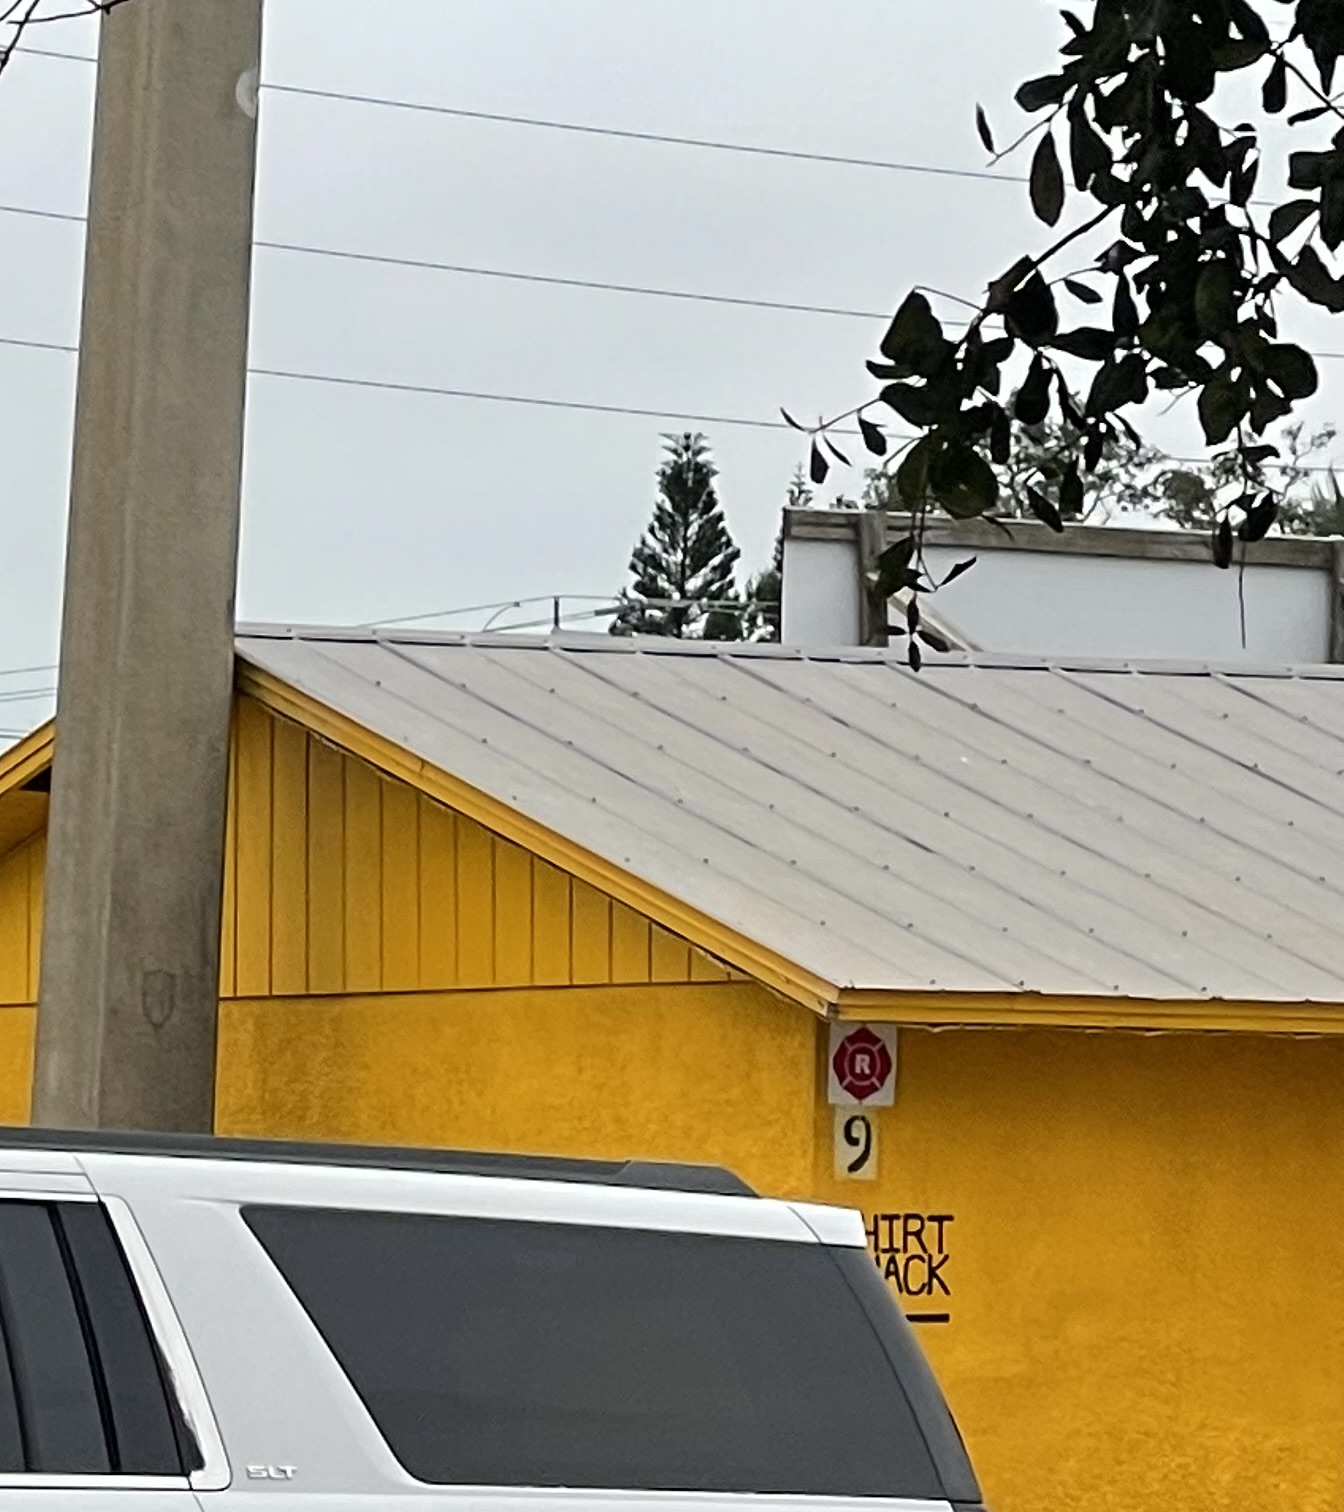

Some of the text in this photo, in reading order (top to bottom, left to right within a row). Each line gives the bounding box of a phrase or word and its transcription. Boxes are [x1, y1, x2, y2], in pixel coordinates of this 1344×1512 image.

[854, 1053, 871, 1075] R
[843, 1115, 873, 1173] 9
[875, 1253, 951, 1296] ACK
[246, 1465, 297, 1480] SLT
